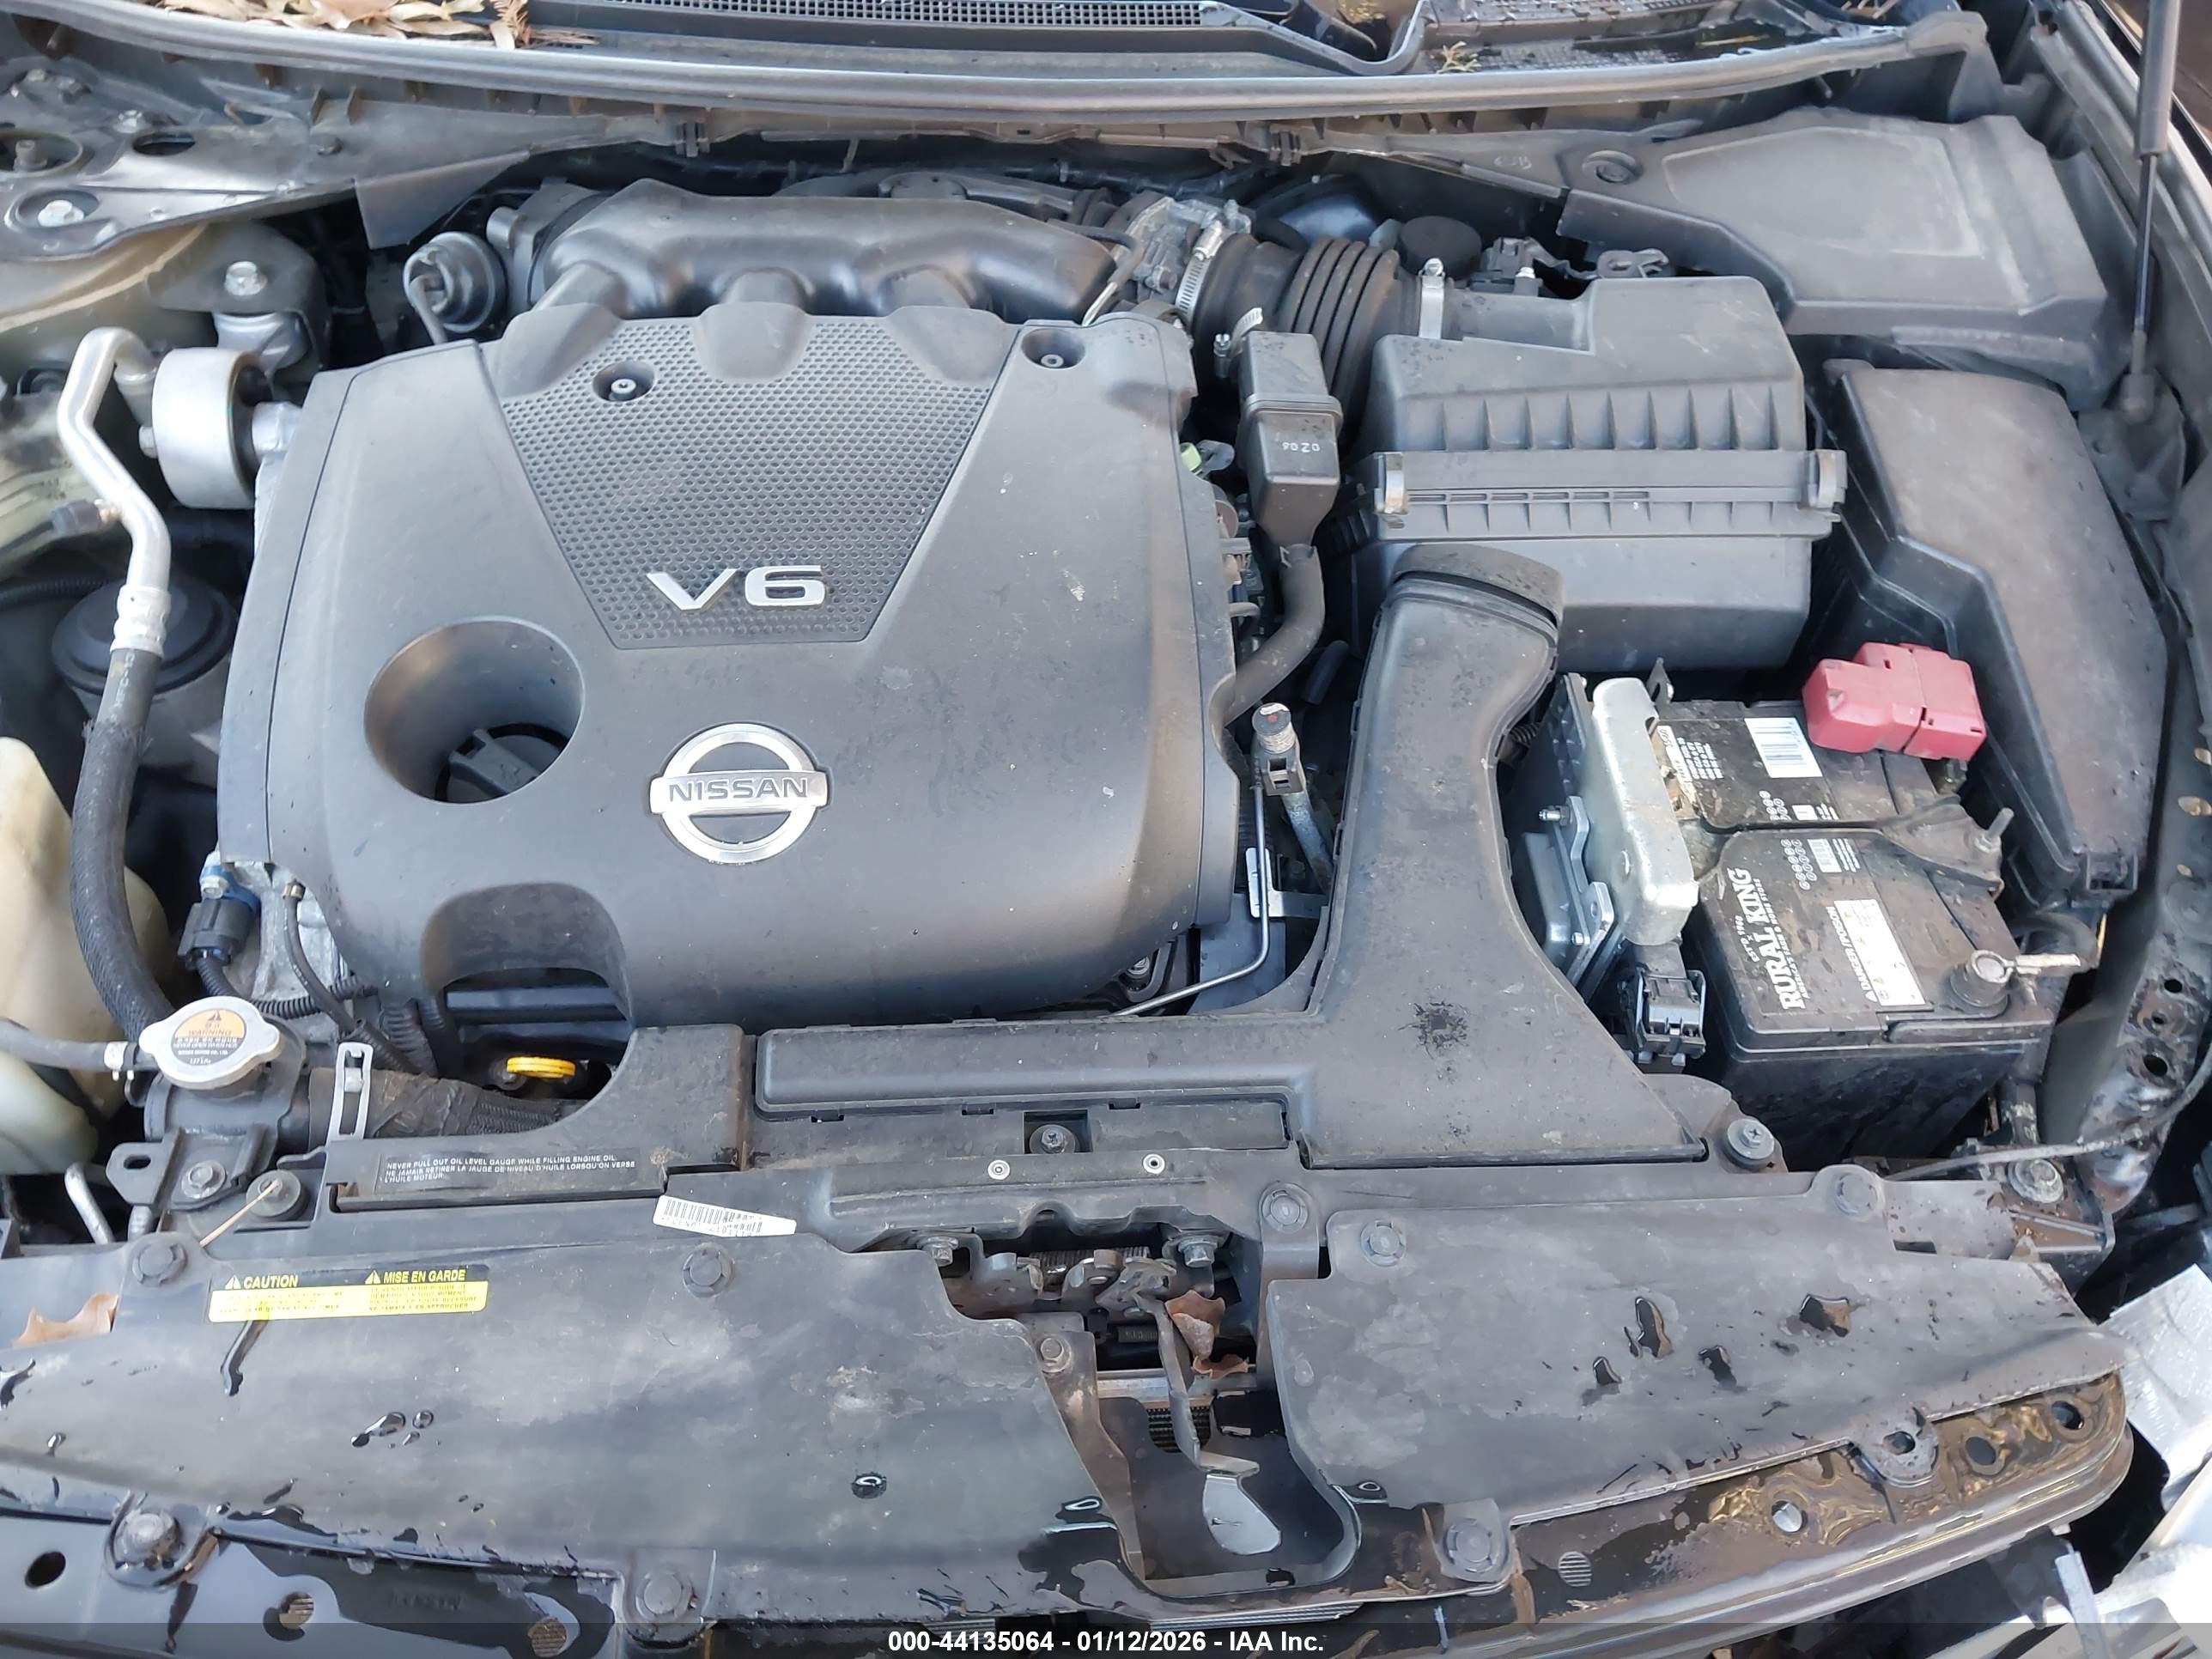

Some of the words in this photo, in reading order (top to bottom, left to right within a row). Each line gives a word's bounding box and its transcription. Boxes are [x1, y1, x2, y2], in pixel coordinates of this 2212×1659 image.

[647, 565, 826, 611] V6
[668, 777, 808, 802] NISSAN
[1727, 867, 1771, 924] KING
[1753, 927, 1806, 1010] RURAL
[243, 1274, 299, 1289] CAUTION
[383, 1271, 410, 1284] MISE
[411, 1270, 426, 1282] EN
[428, 1269, 466, 1281] GARDE
